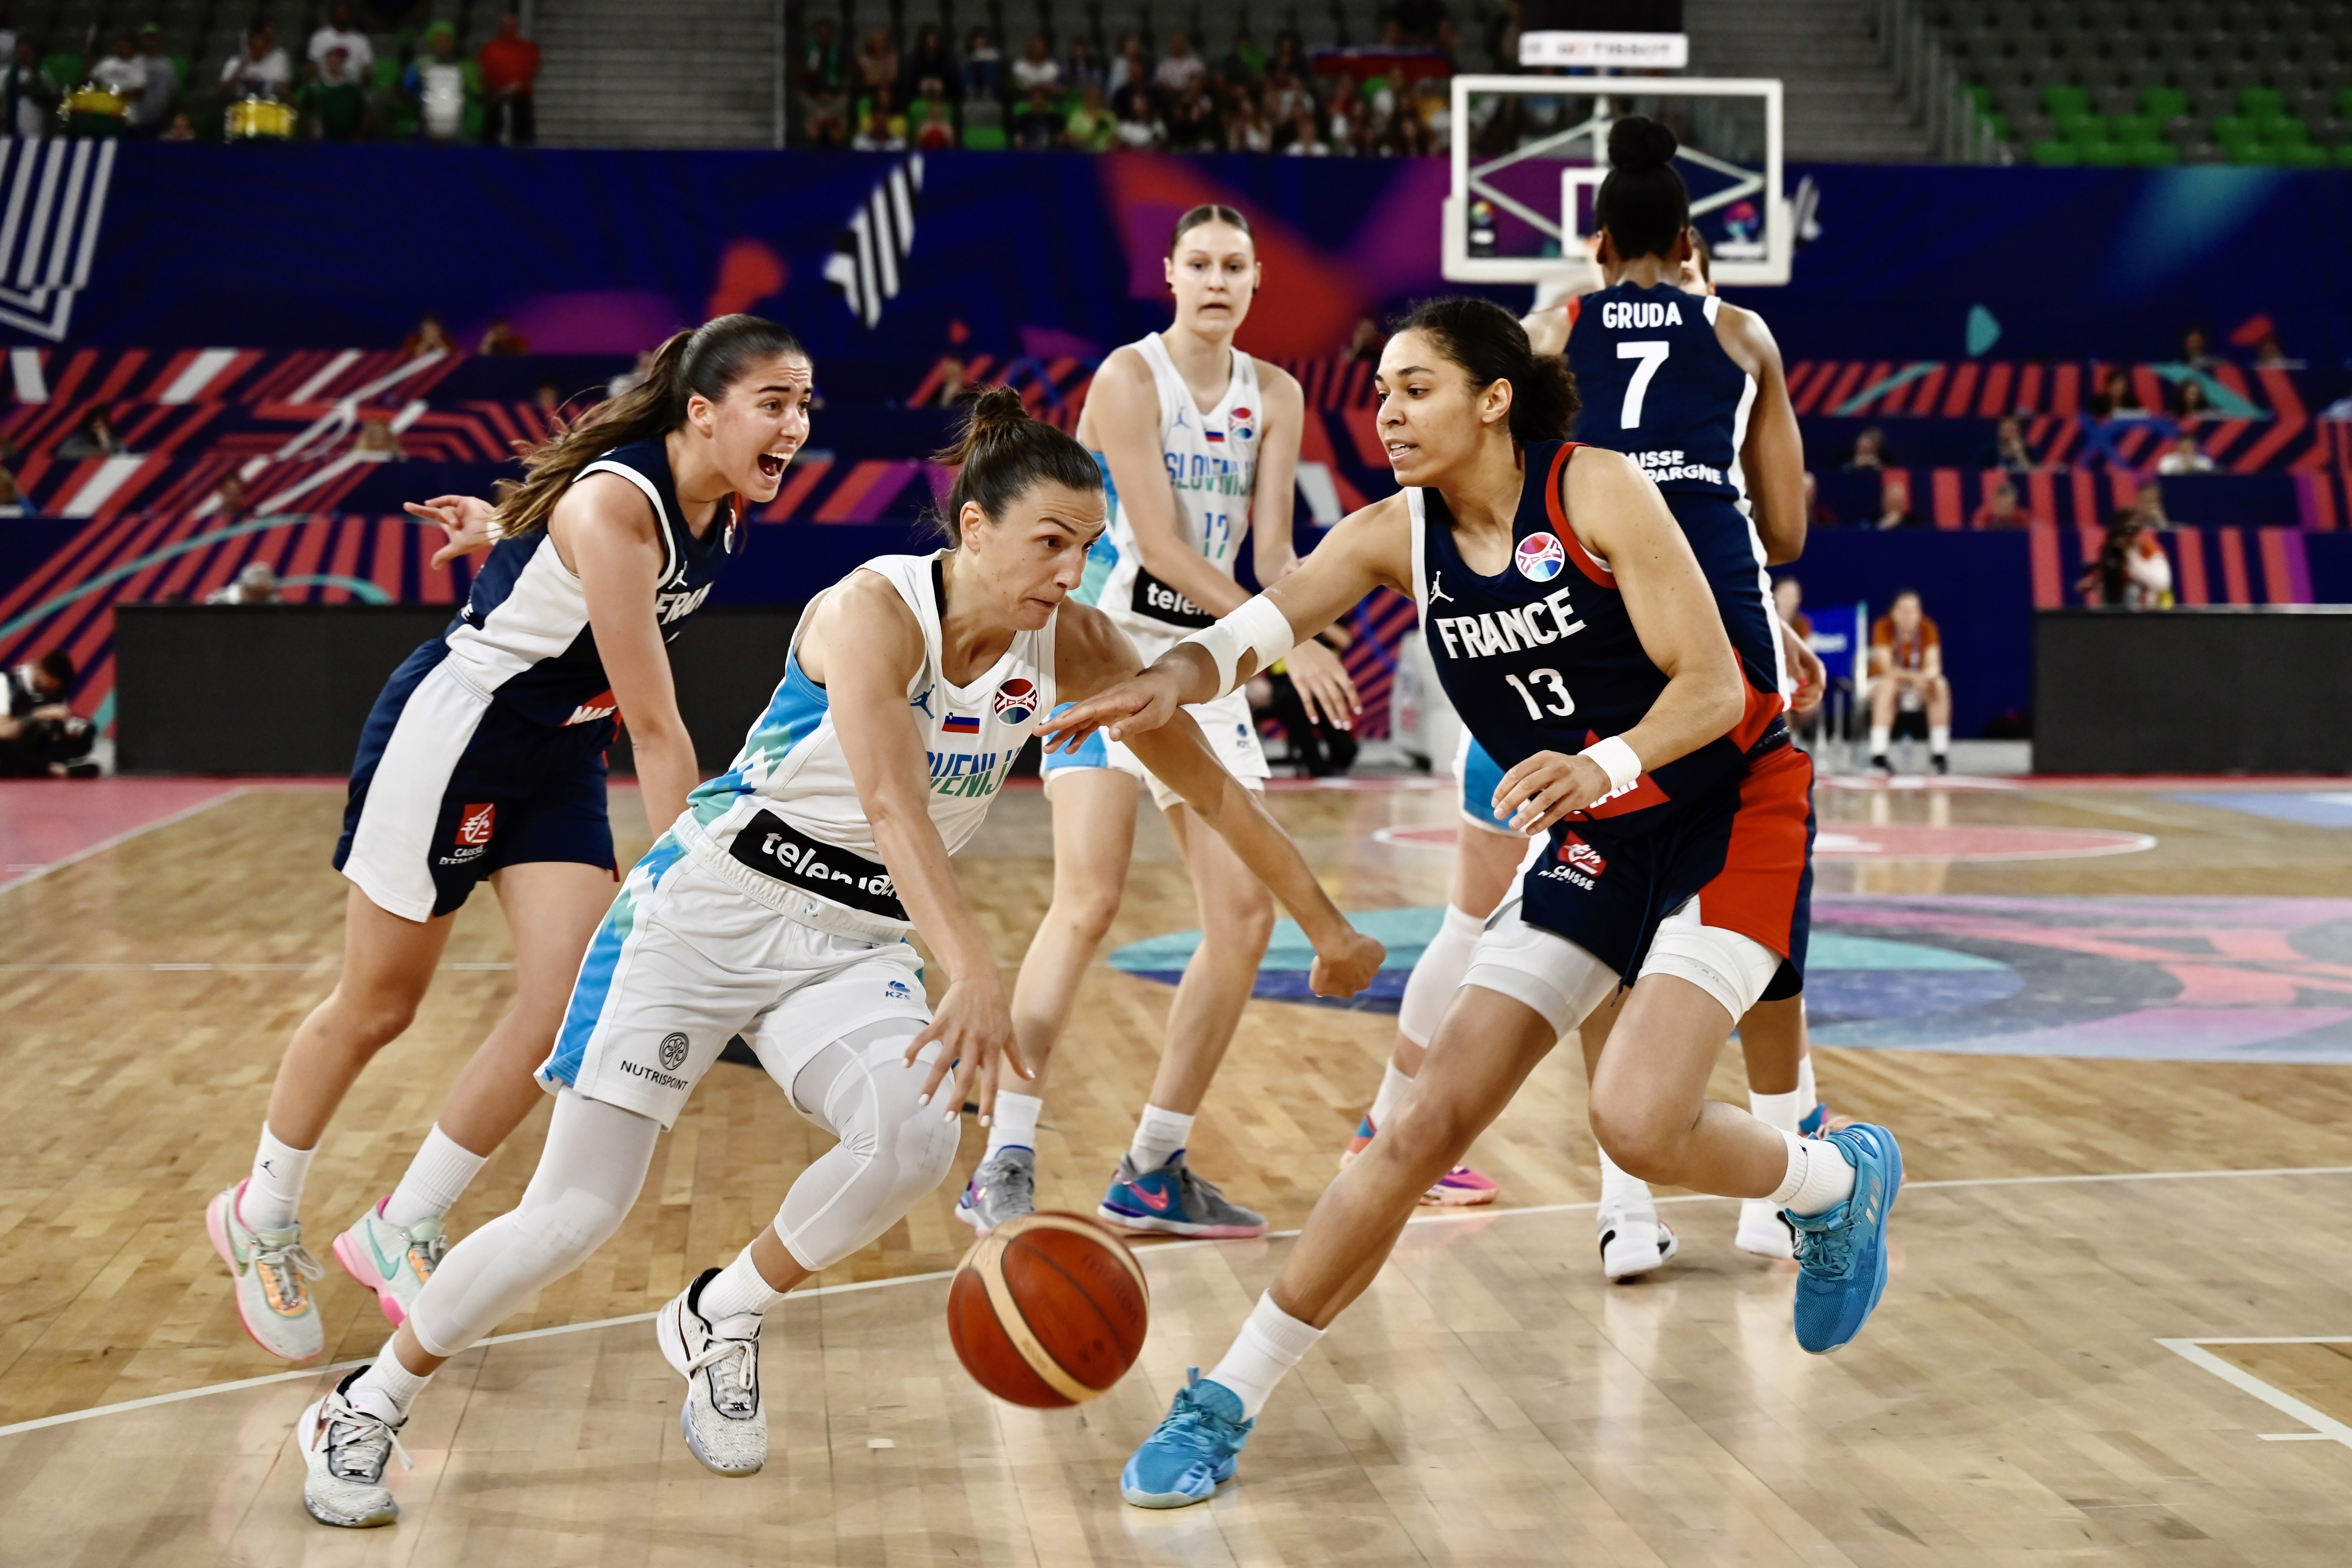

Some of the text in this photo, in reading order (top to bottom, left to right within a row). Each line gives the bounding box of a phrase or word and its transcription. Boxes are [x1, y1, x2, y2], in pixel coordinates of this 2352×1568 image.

[1602, 301, 1683, 329] GRUDA
[1617, 341, 1669, 430] 7
[1621, 450, 1685, 468] AISSE
[1644, 464, 1723, 485] PARGNE
[1147, 582, 1209, 615] tele
[1434, 586, 1587, 658] FRANCE
[994, 689, 1038, 715] 2023
[1505, 668, 1575, 720] 13
[1553, 865, 1596, 891] CAISSE
[886, 991, 911, 1000] KZS
[620, 1060, 689, 1091] NUTRISPOINT
